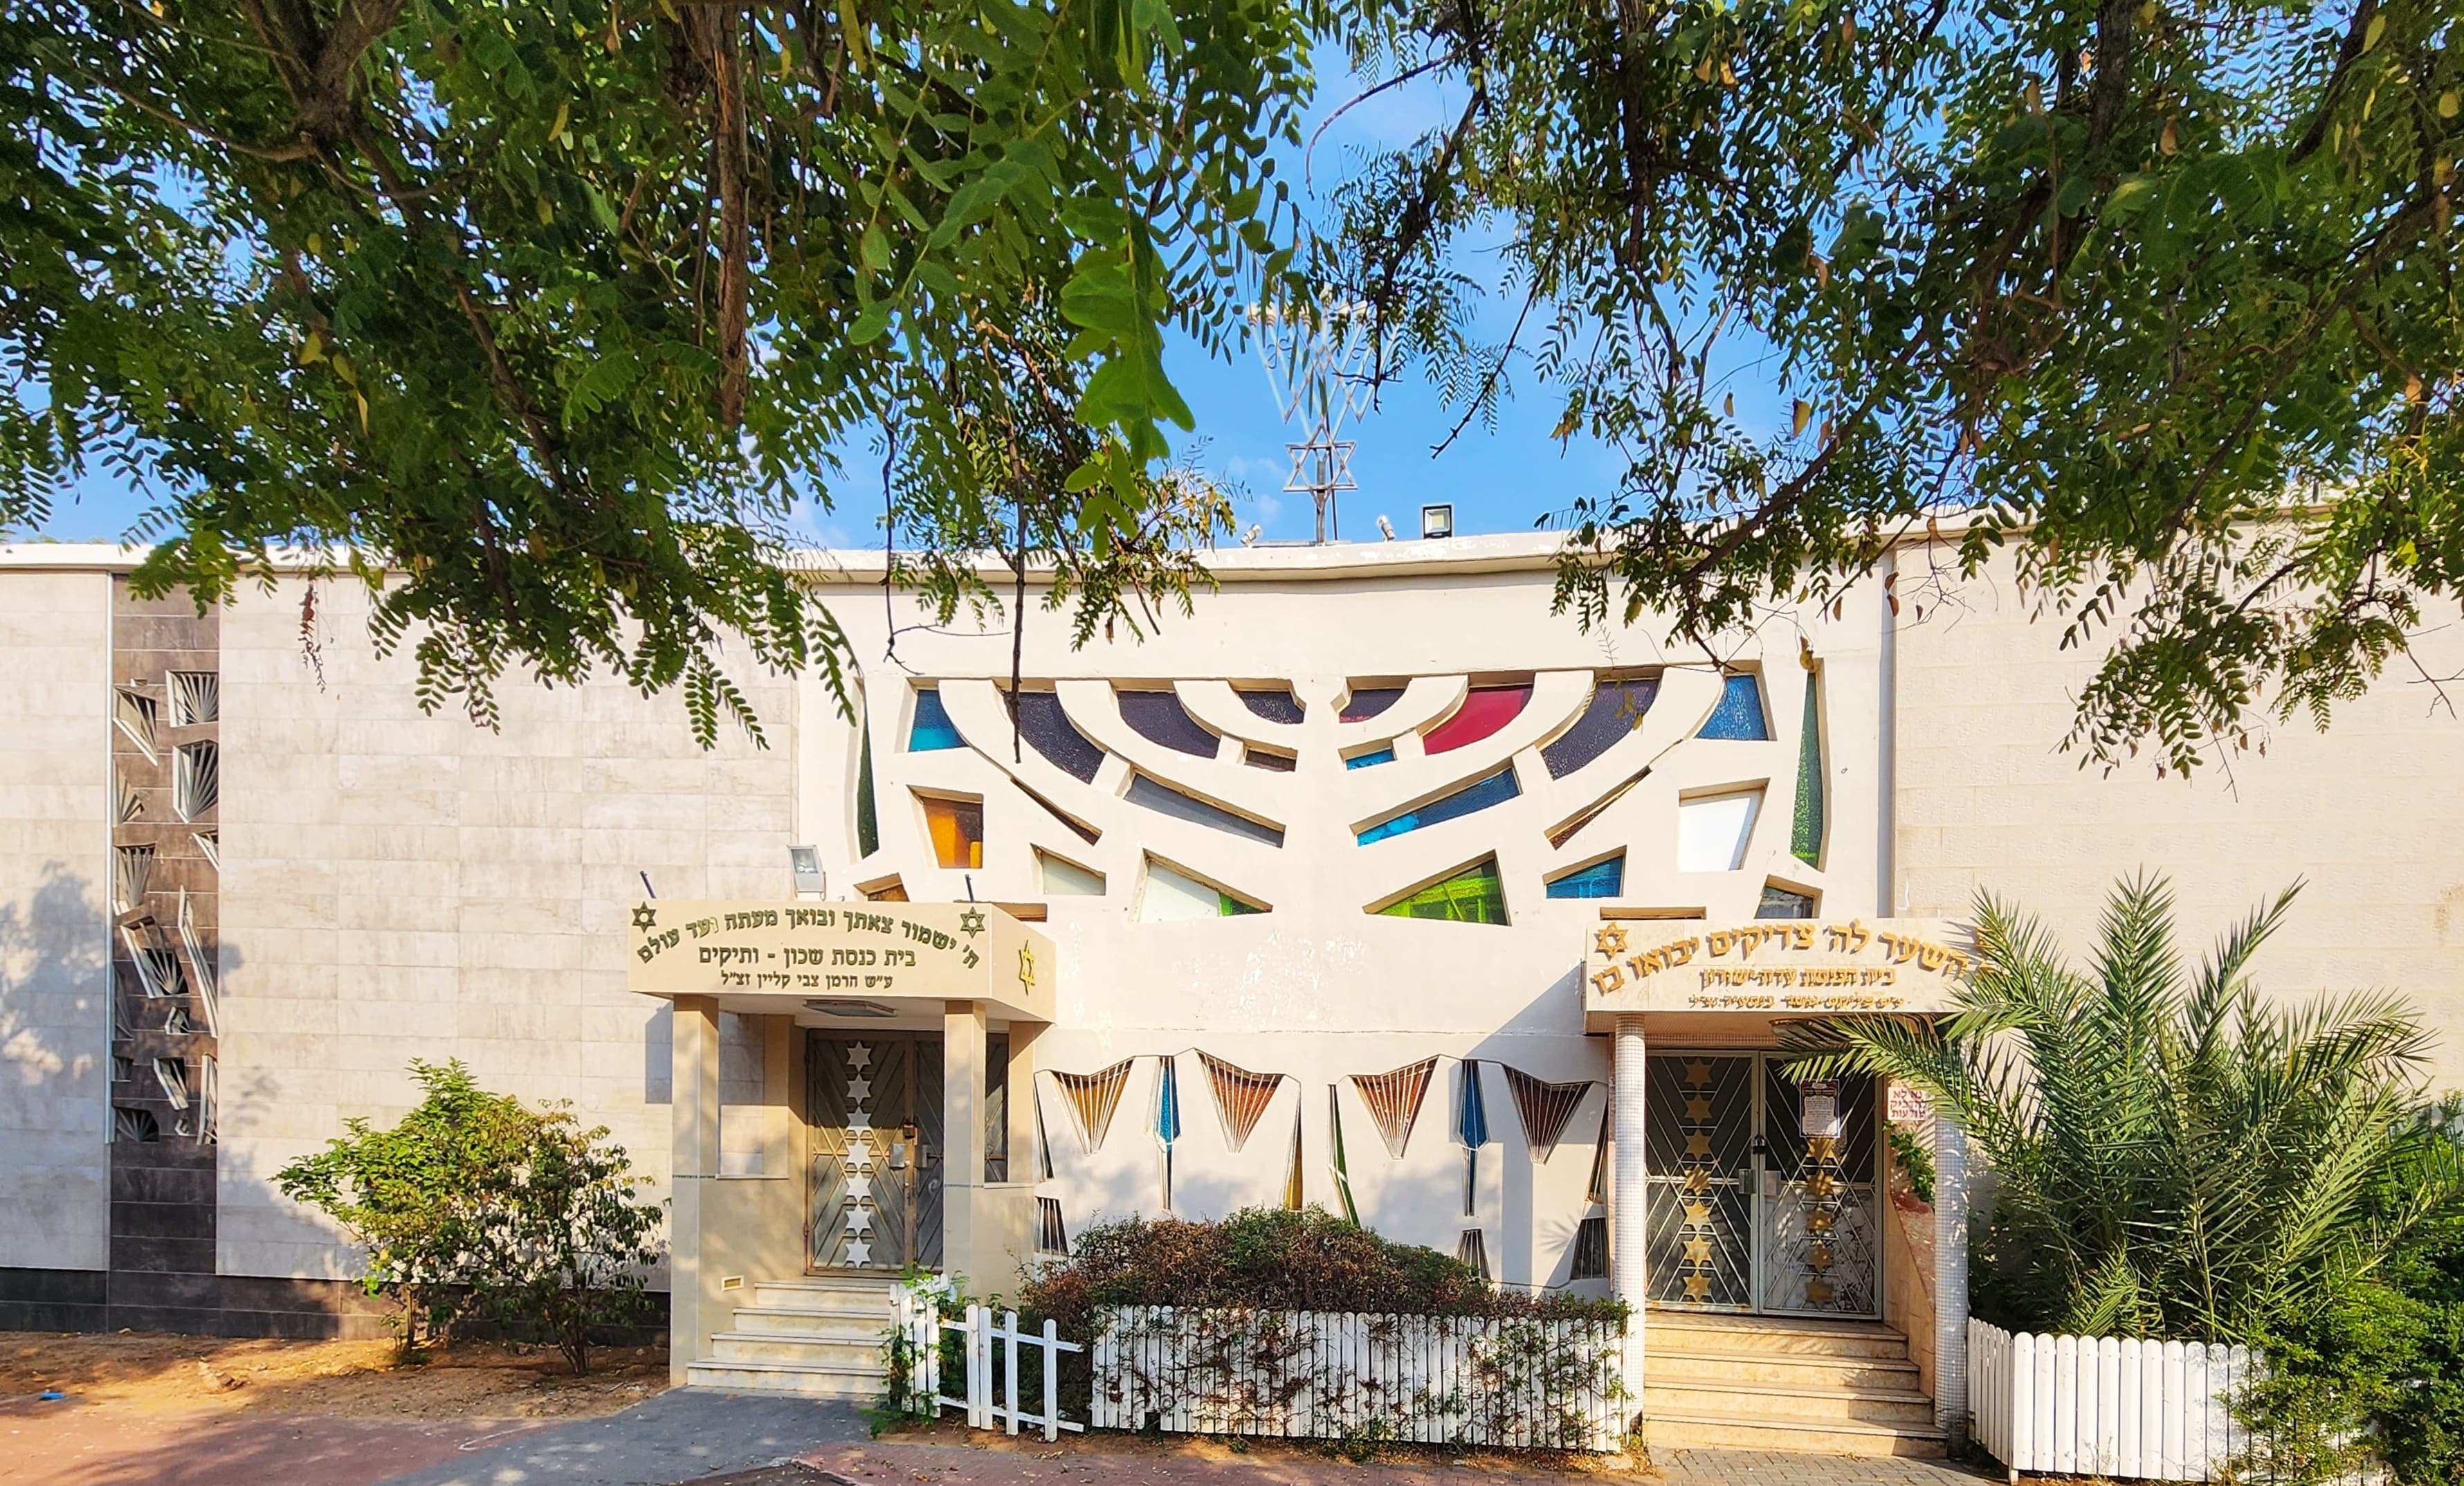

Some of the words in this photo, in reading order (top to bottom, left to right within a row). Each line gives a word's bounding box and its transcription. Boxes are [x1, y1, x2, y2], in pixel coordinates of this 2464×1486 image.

[686, 916, 719, 939] ועד
[724, 909, 778, 930] מעתה
[785, 908, 835, 930] ובואך
[843, 910, 894, 934] צאתך
[637, 928, 679, 963] עולם
[901, 920, 957, 950] ישמור
[1710, 923, 1816, 959] צדיקים
[699, 946, 758, 967] ותיקים
[783, 948, 823, 968] שכון
[831, 948, 876, 966] כנסת
[884, 949, 916, 966] בית
[962, 944, 980, 969] ה'
[1629, 936, 1699, 978] יבואו
[1882, 930, 1969, 979] השער
[757, 971, 790, 989] קליין
[797, 974, 819, 987] צבי
[825, 974, 857, 990] הרמן
[1593, 965, 1625, 993] בו
[1801, 968, 1859, 986] הכנסת
[1862, 968, 1897, 986] בית
[1893, 1088, 1907, 1099] לא
[1910, 1090, 1922, 1099] נא
